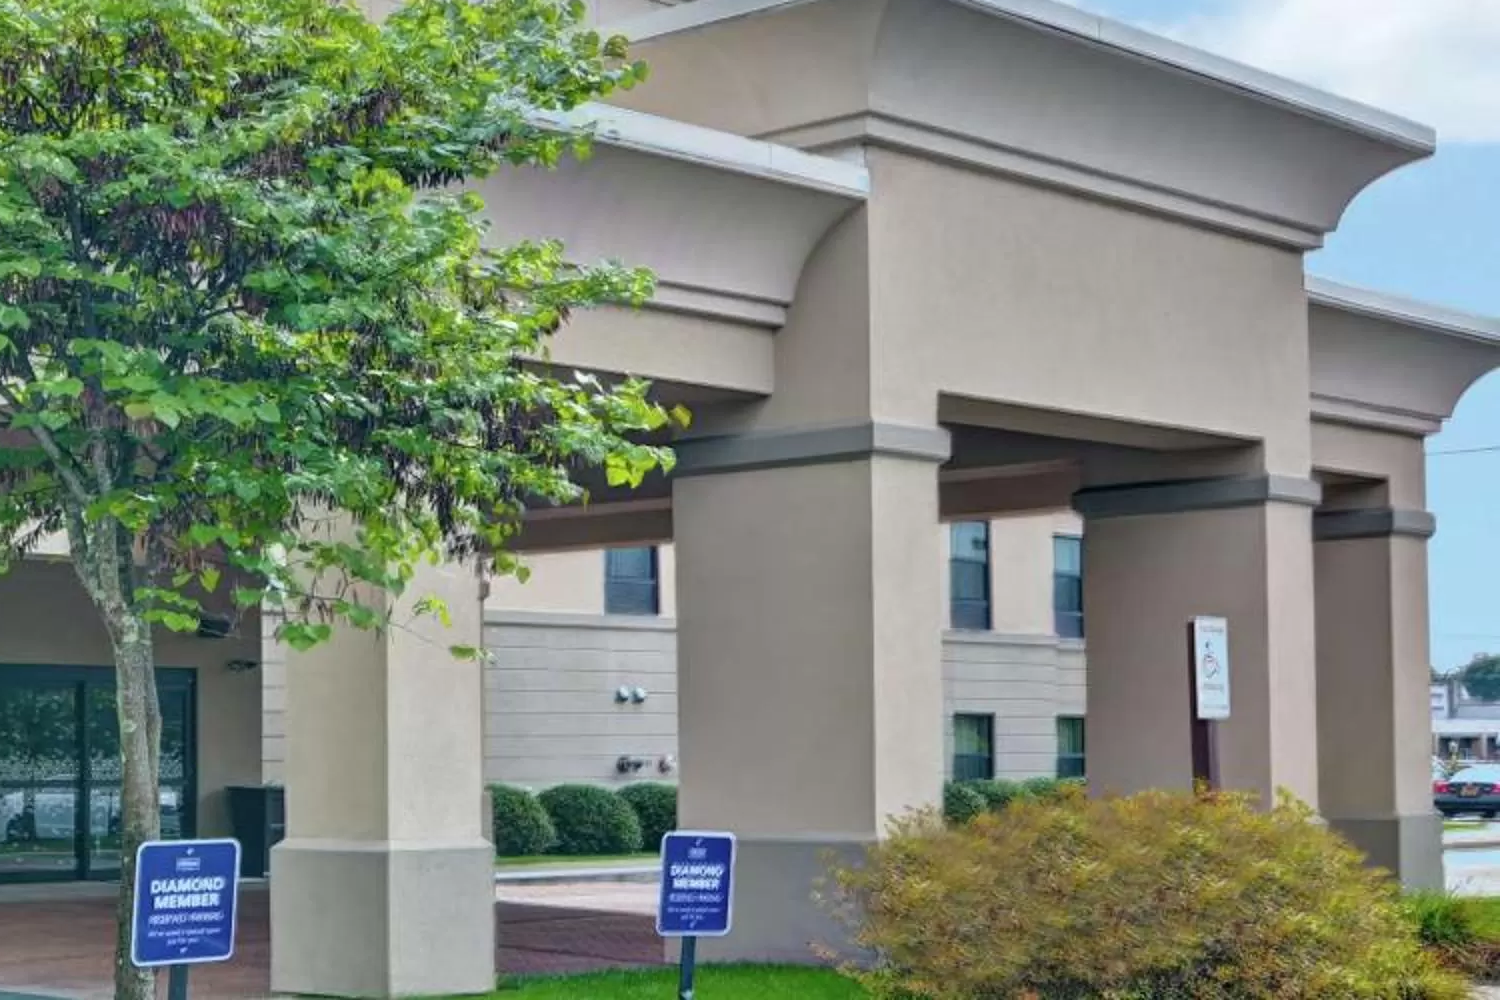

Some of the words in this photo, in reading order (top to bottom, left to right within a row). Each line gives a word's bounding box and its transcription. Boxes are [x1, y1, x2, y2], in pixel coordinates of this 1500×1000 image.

[670, 864, 725, 877] DIAMOND
[151, 877, 226, 895] DIAMOND
[672, 878, 720, 890] MEMBER
[153, 892, 220, 909] MEMBER
